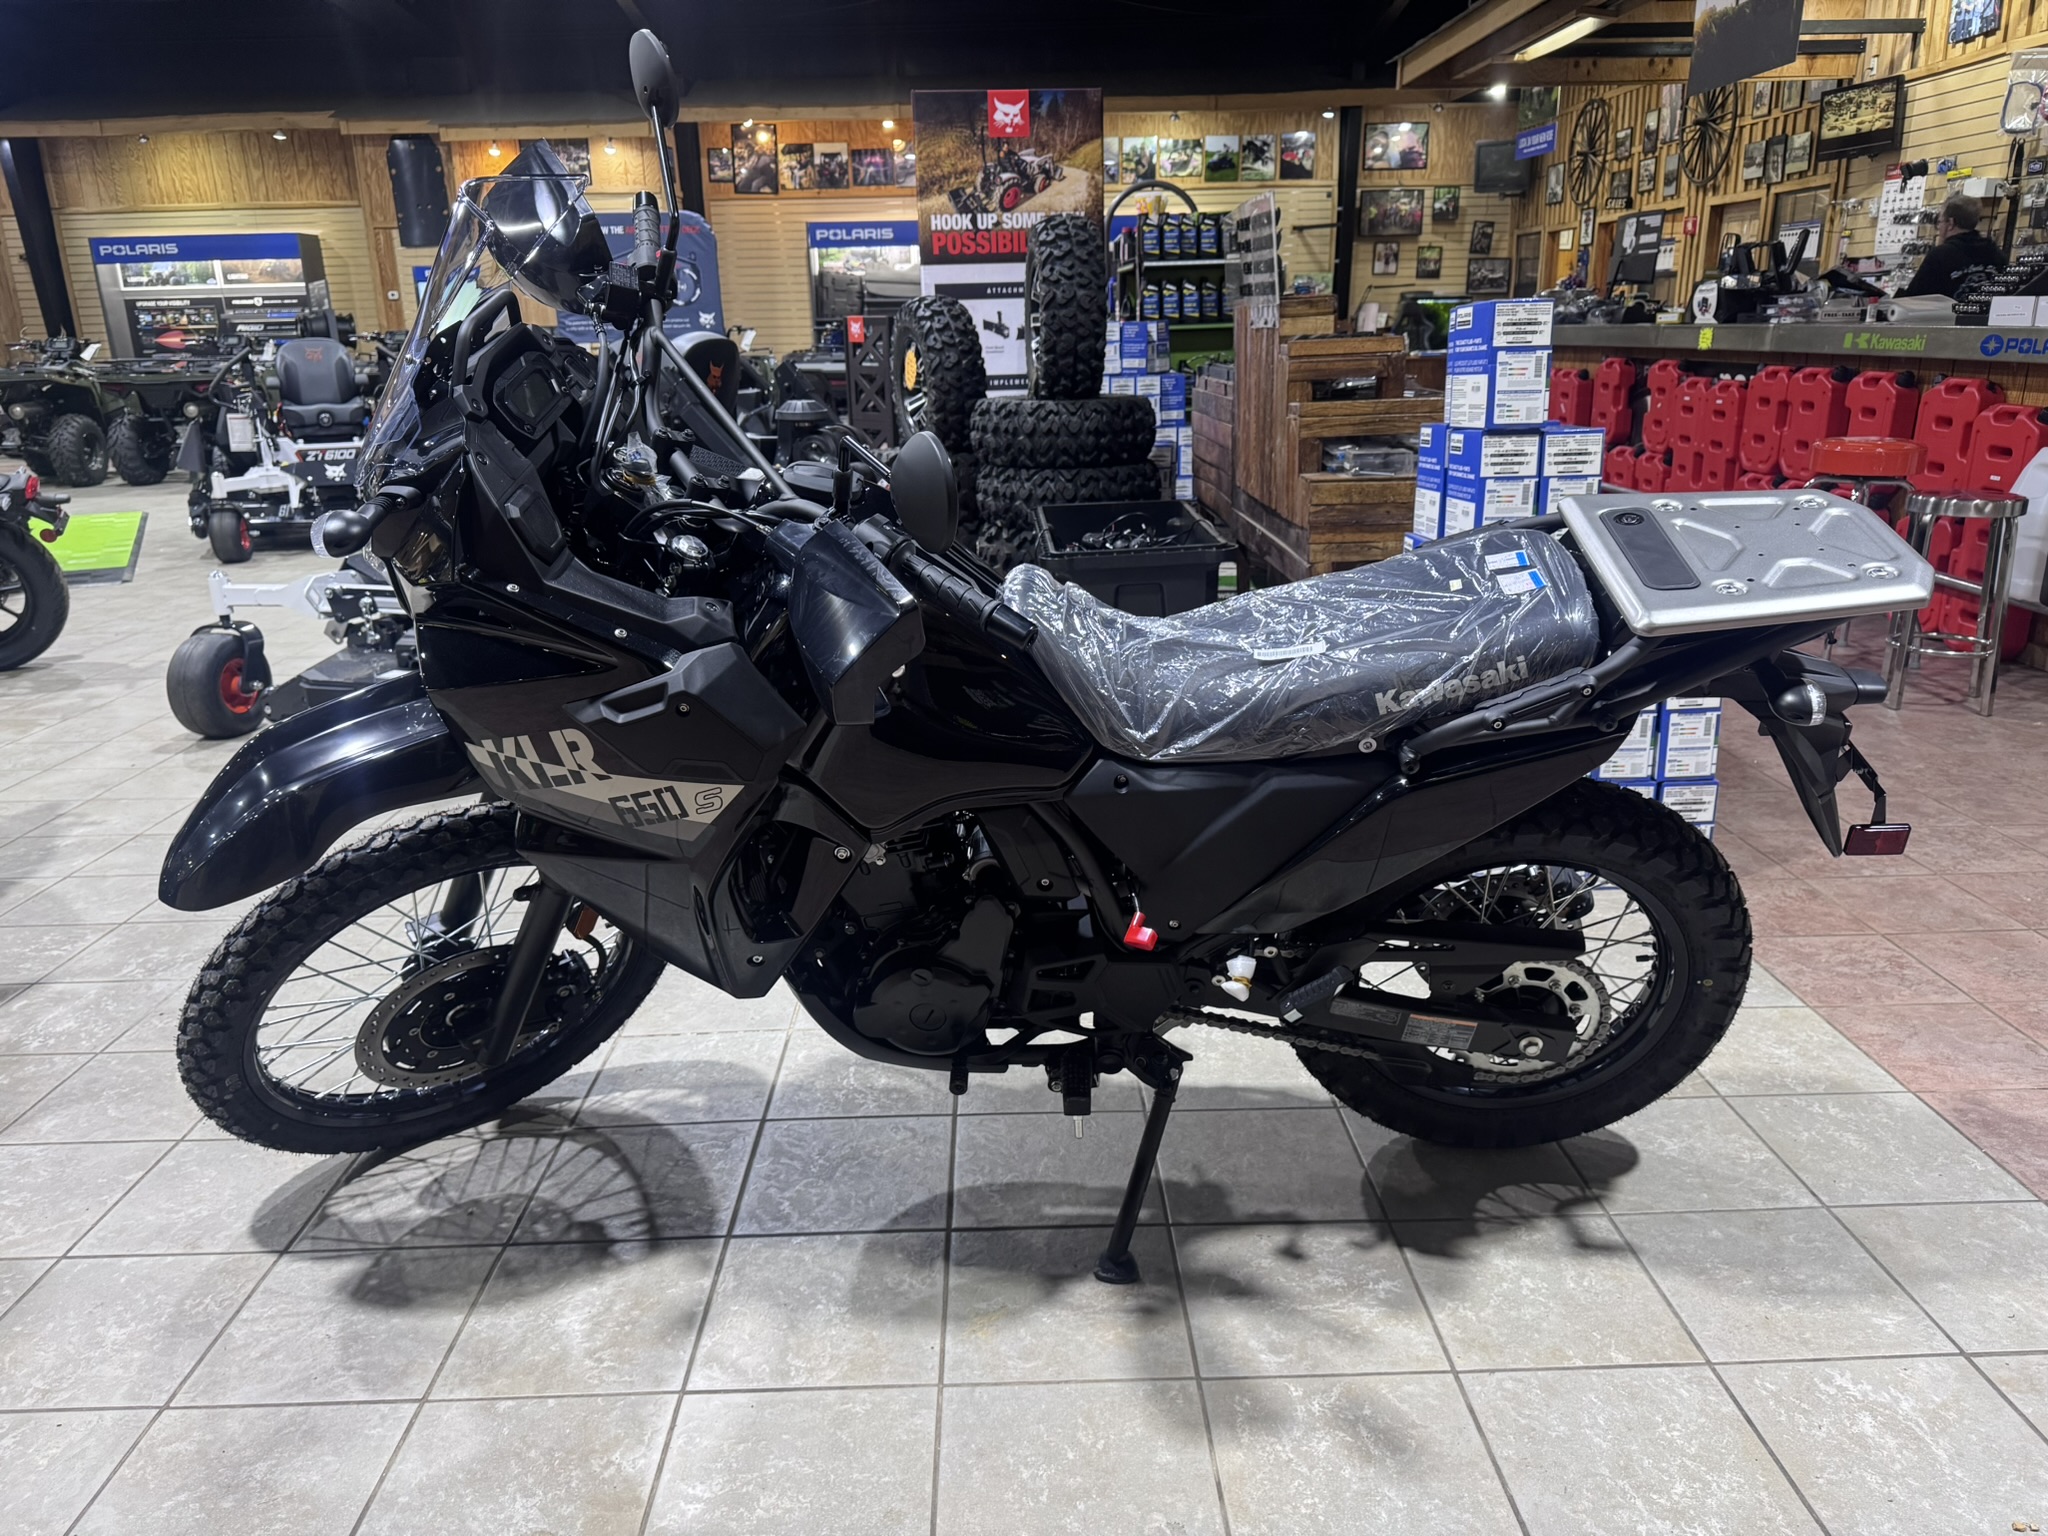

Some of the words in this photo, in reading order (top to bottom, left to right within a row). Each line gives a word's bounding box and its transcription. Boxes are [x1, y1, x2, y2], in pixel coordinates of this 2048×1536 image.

[930, 213, 973, 231] HOOK
[977, 213, 998, 230] UP
[610, 225, 625, 235] THE
[816, 228, 894, 241] POLARIS
[99, 243, 179, 256] POLARIS
[931, 230, 1028, 256] POSSIBIL
[986, 286, 1024, 294] ATTACHM
[1869, 332, 1927, 351] Kawasaki
[989, 377, 1029, 386] IMPLEME
[305, 448, 357, 461] ZT6100
[1374, 654, 1529, 716] Kawasaki
[480, 728, 613, 790] KLR
[607, 785, 690, 829] 650
[694, 787, 724, 815] S
